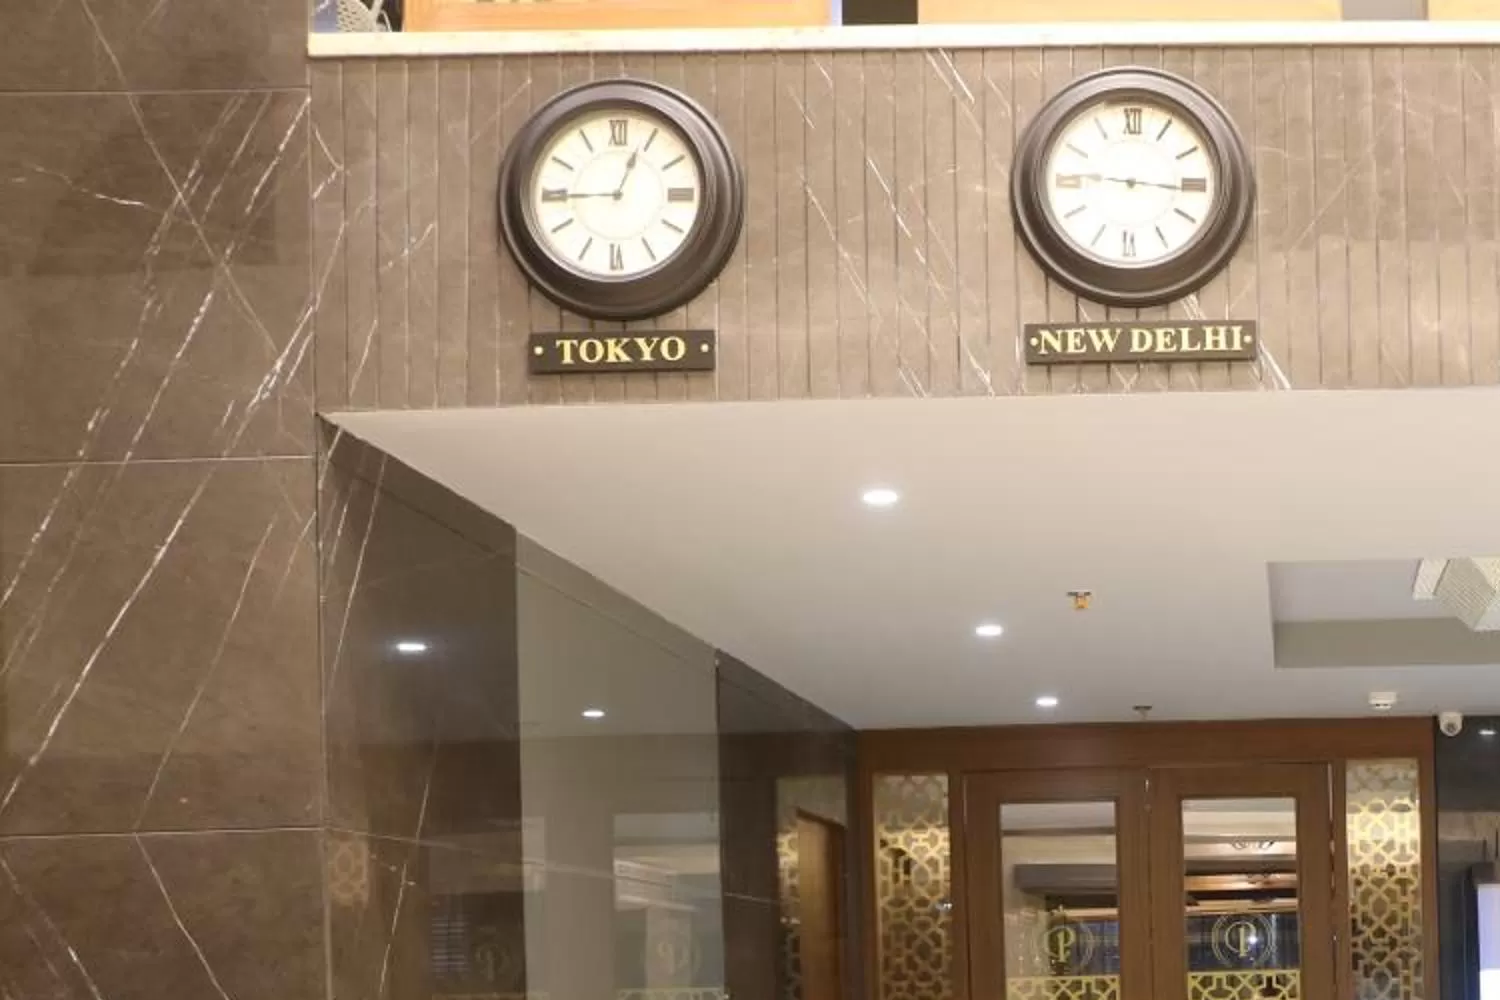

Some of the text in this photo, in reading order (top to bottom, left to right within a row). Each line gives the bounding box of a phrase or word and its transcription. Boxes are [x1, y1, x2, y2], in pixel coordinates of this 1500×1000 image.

[556, 336, 687, 365] TOKYO
[1038, 325, 1244, 354] NEW DELHI
